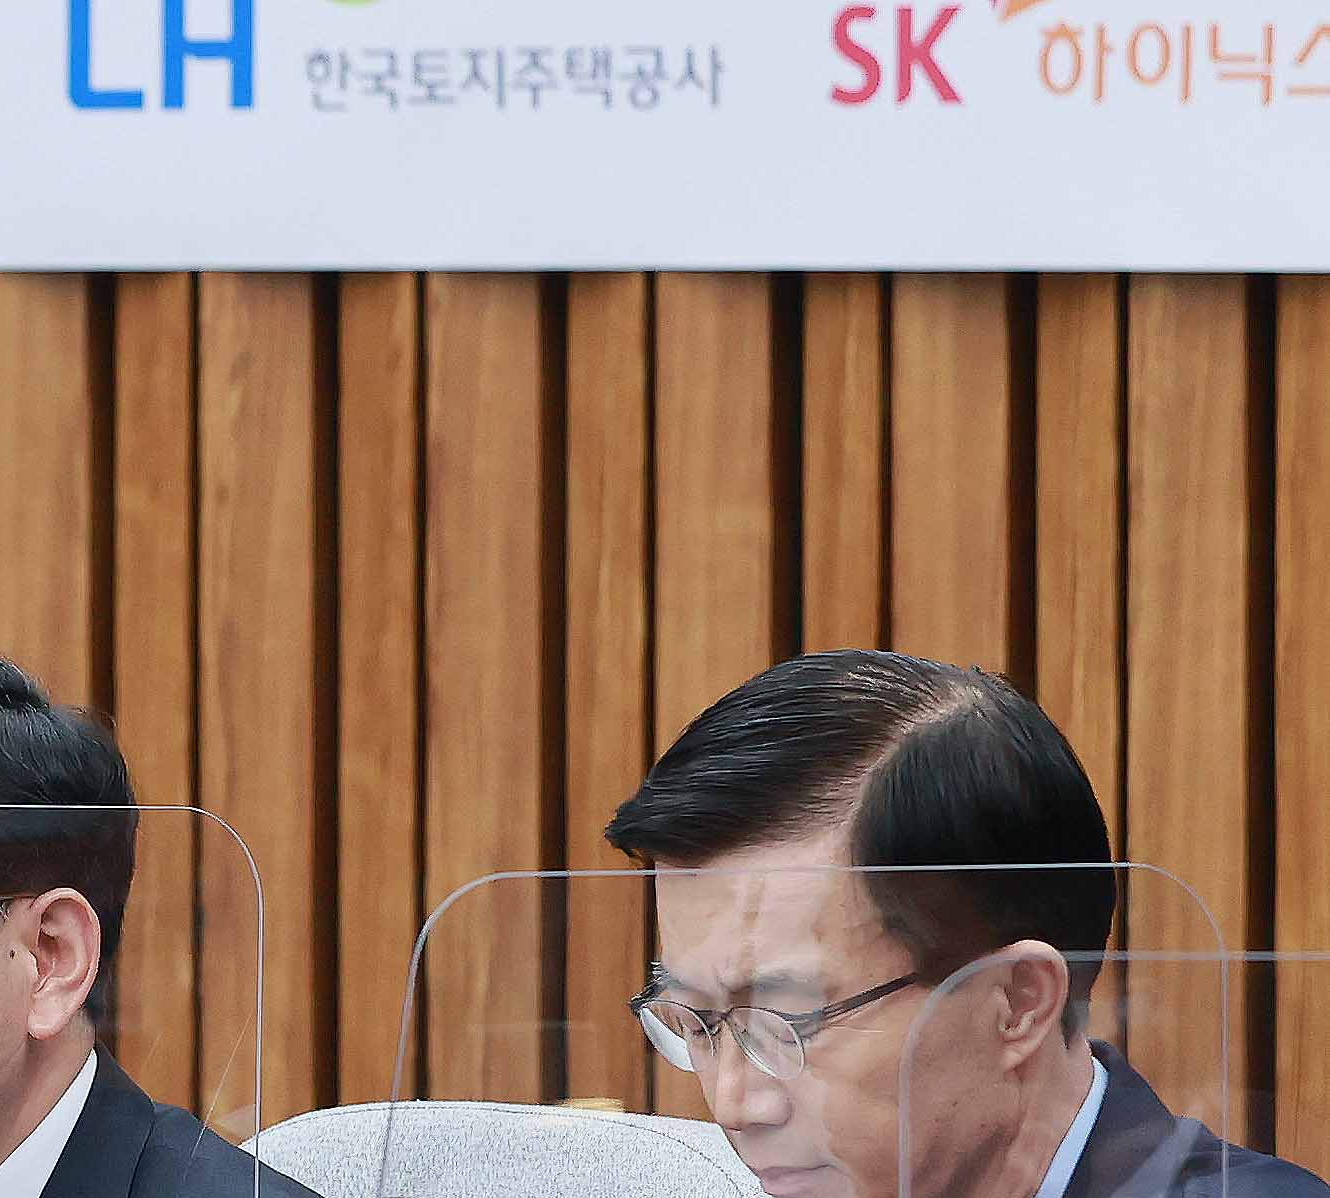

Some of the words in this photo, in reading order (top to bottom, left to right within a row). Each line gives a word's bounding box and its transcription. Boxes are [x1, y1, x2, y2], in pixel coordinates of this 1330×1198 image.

[67, 0, 254, 108] LH
[305, 45, 726, 111] 한국토지주택공사
[830, 3, 963, 106] SK
